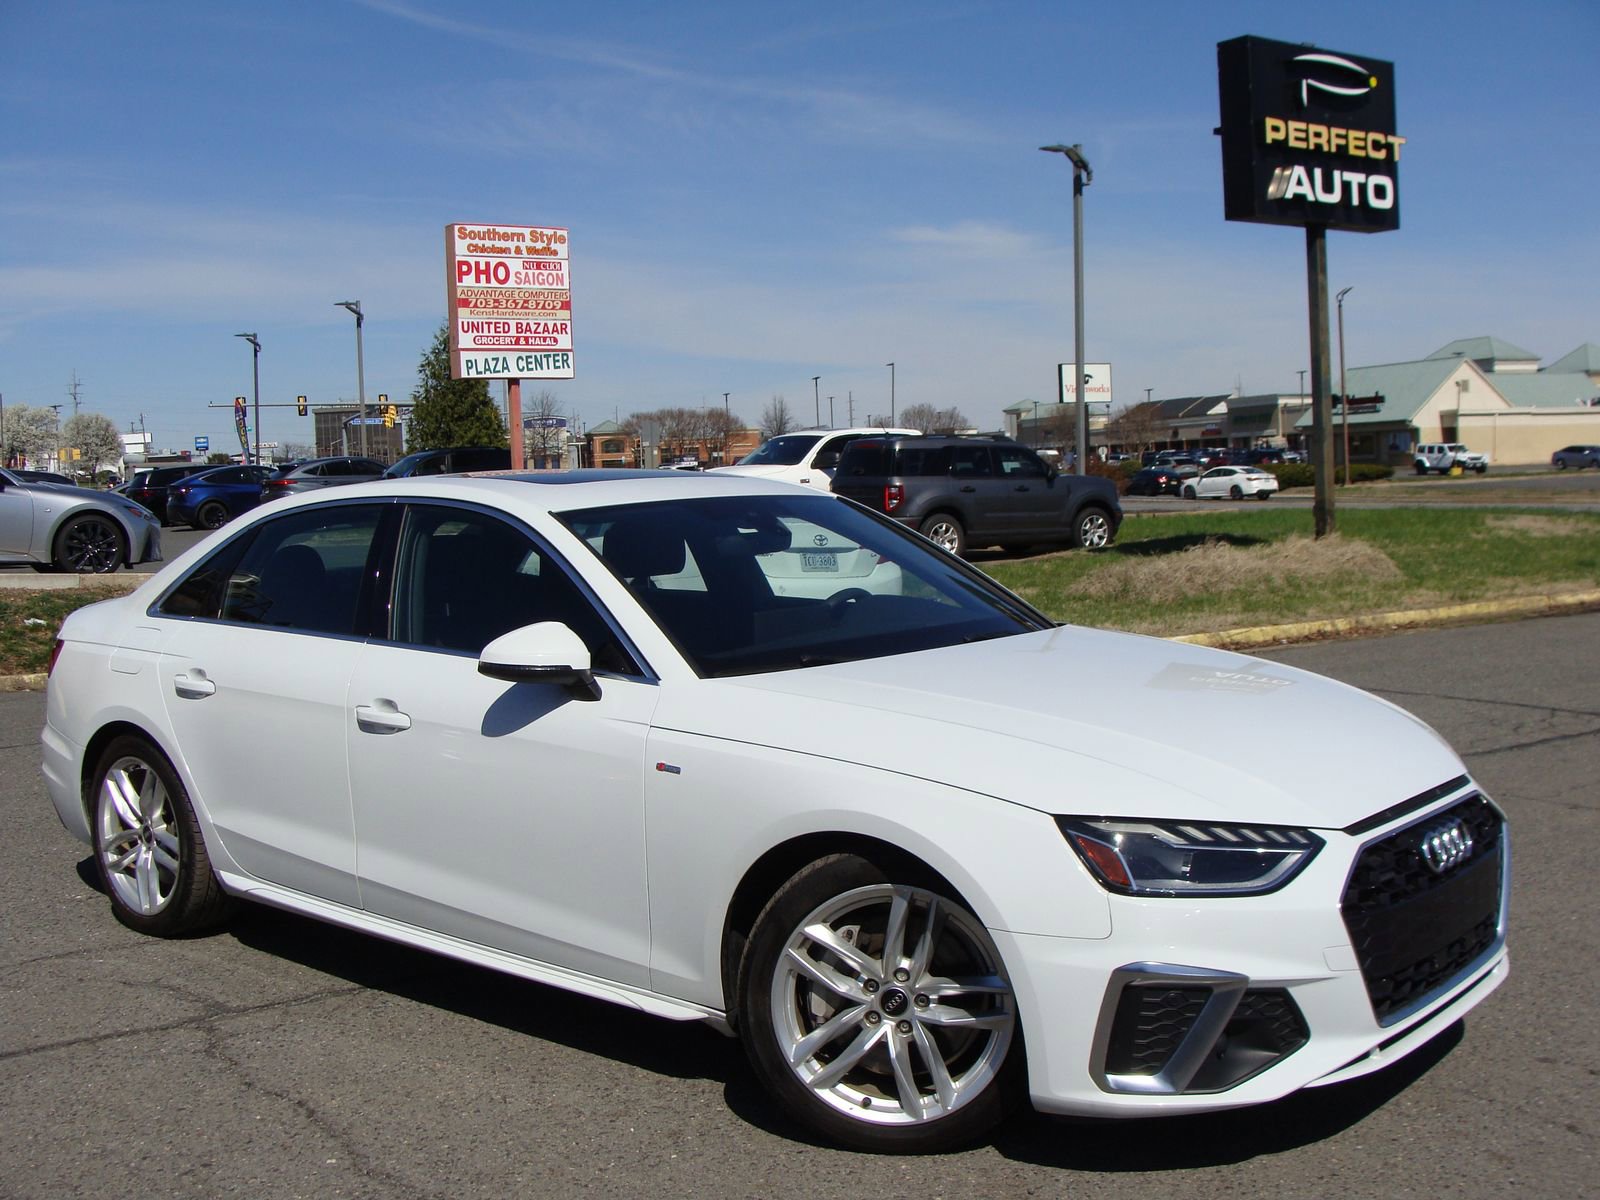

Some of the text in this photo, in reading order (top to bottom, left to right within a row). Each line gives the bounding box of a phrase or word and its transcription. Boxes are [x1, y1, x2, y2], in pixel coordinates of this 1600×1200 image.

[1265, 116, 1407, 162] PERFECT
[1284, 164, 1395, 210] AUTO
[457, 226, 567, 246] Southern Style
[466, 243, 558, 256] Chicken & Waffle
[457, 260, 511, 285] PHO
[514, 271, 565, 287] SAIGON
[460, 289, 569, 300] ADVANTAGE COMPUTERS
[468, 298, 562, 310] 703-367-8709
[469, 309, 557, 318] KensHardware.com
[461, 321, 568, 335] UNITED BAZAAR
[475, 336, 556, 345] GROCERY & HALAL
[465, 352, 571, 376] PLAZA CENTER
